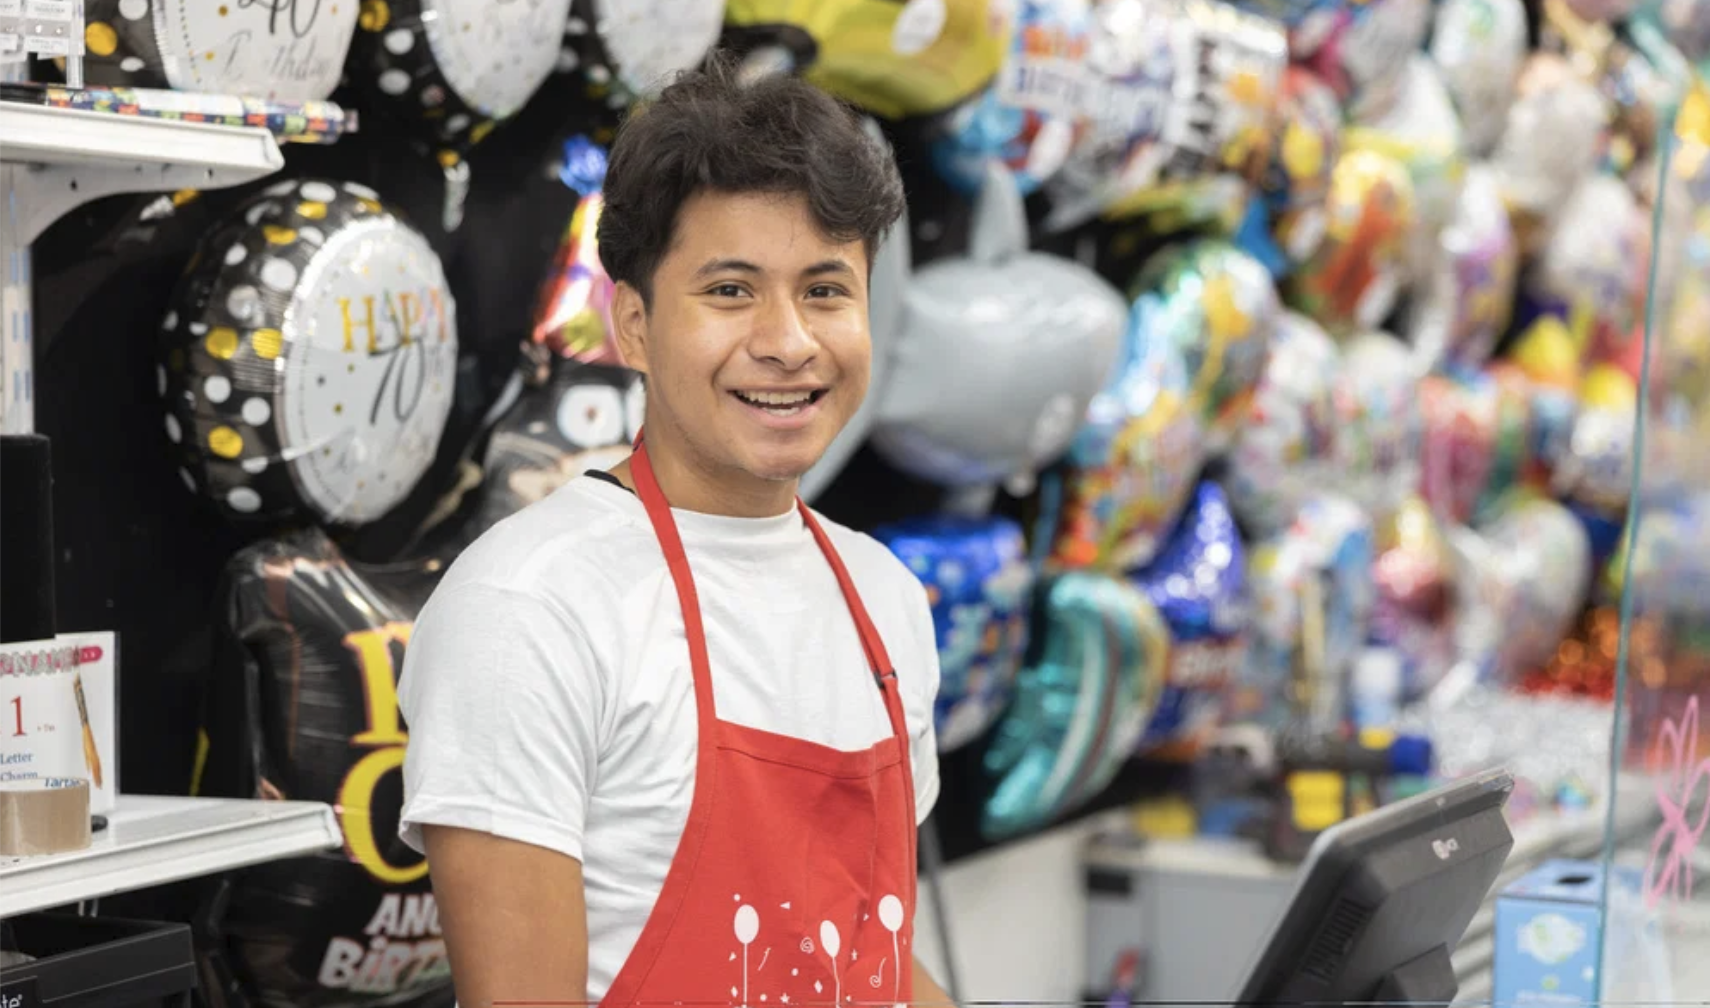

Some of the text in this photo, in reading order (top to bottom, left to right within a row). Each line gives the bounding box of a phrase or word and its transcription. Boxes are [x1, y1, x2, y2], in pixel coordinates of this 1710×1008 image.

[367, 335, 426, 427] 70
[10, 695, 27, 737] 1
[0, 752, 34, 764] Letter
